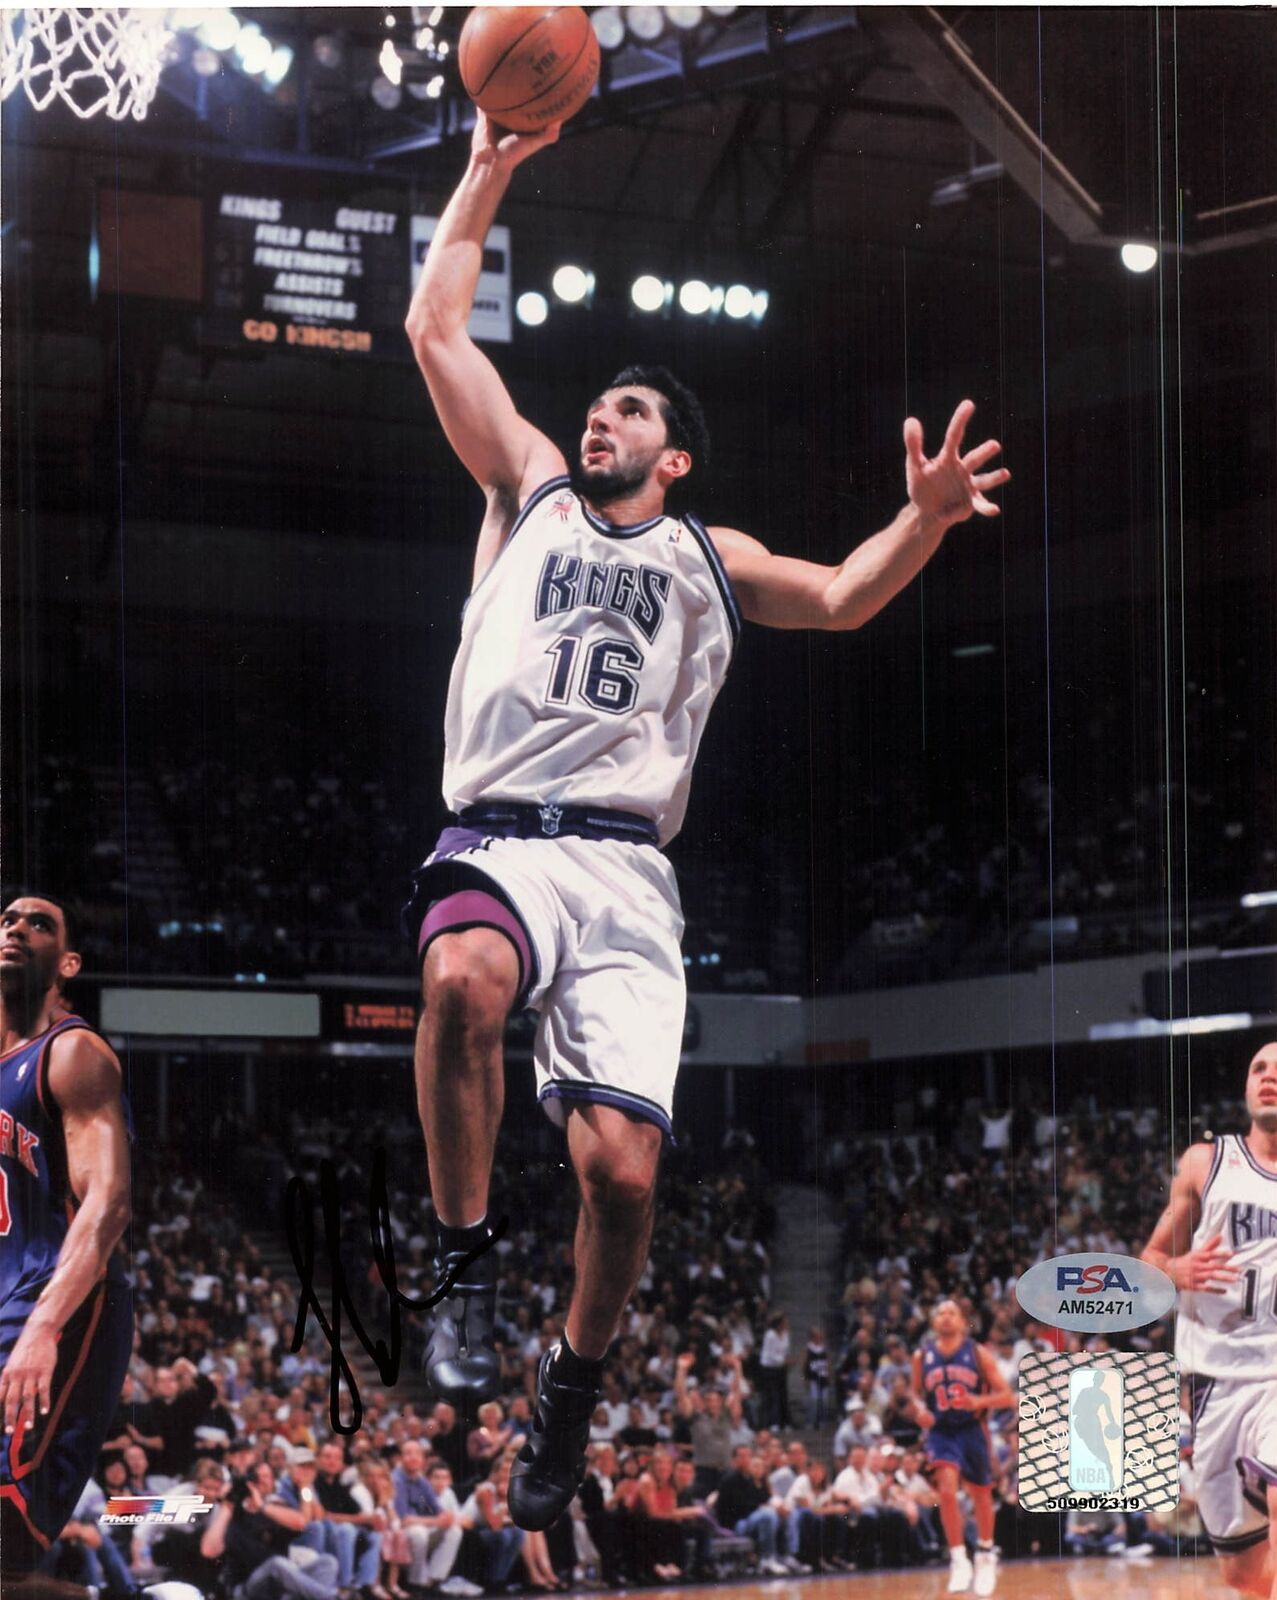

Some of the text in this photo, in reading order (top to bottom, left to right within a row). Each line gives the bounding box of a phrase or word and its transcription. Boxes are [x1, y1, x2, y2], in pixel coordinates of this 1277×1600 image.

[220, 195, 397, 234] KINGS GUEST
[254, 223, 302, 247] FIELD
[243, 319, 278, 343] GO
[535, 550, 674, 646] KINGS
[545, 635, 645, 715] 16
